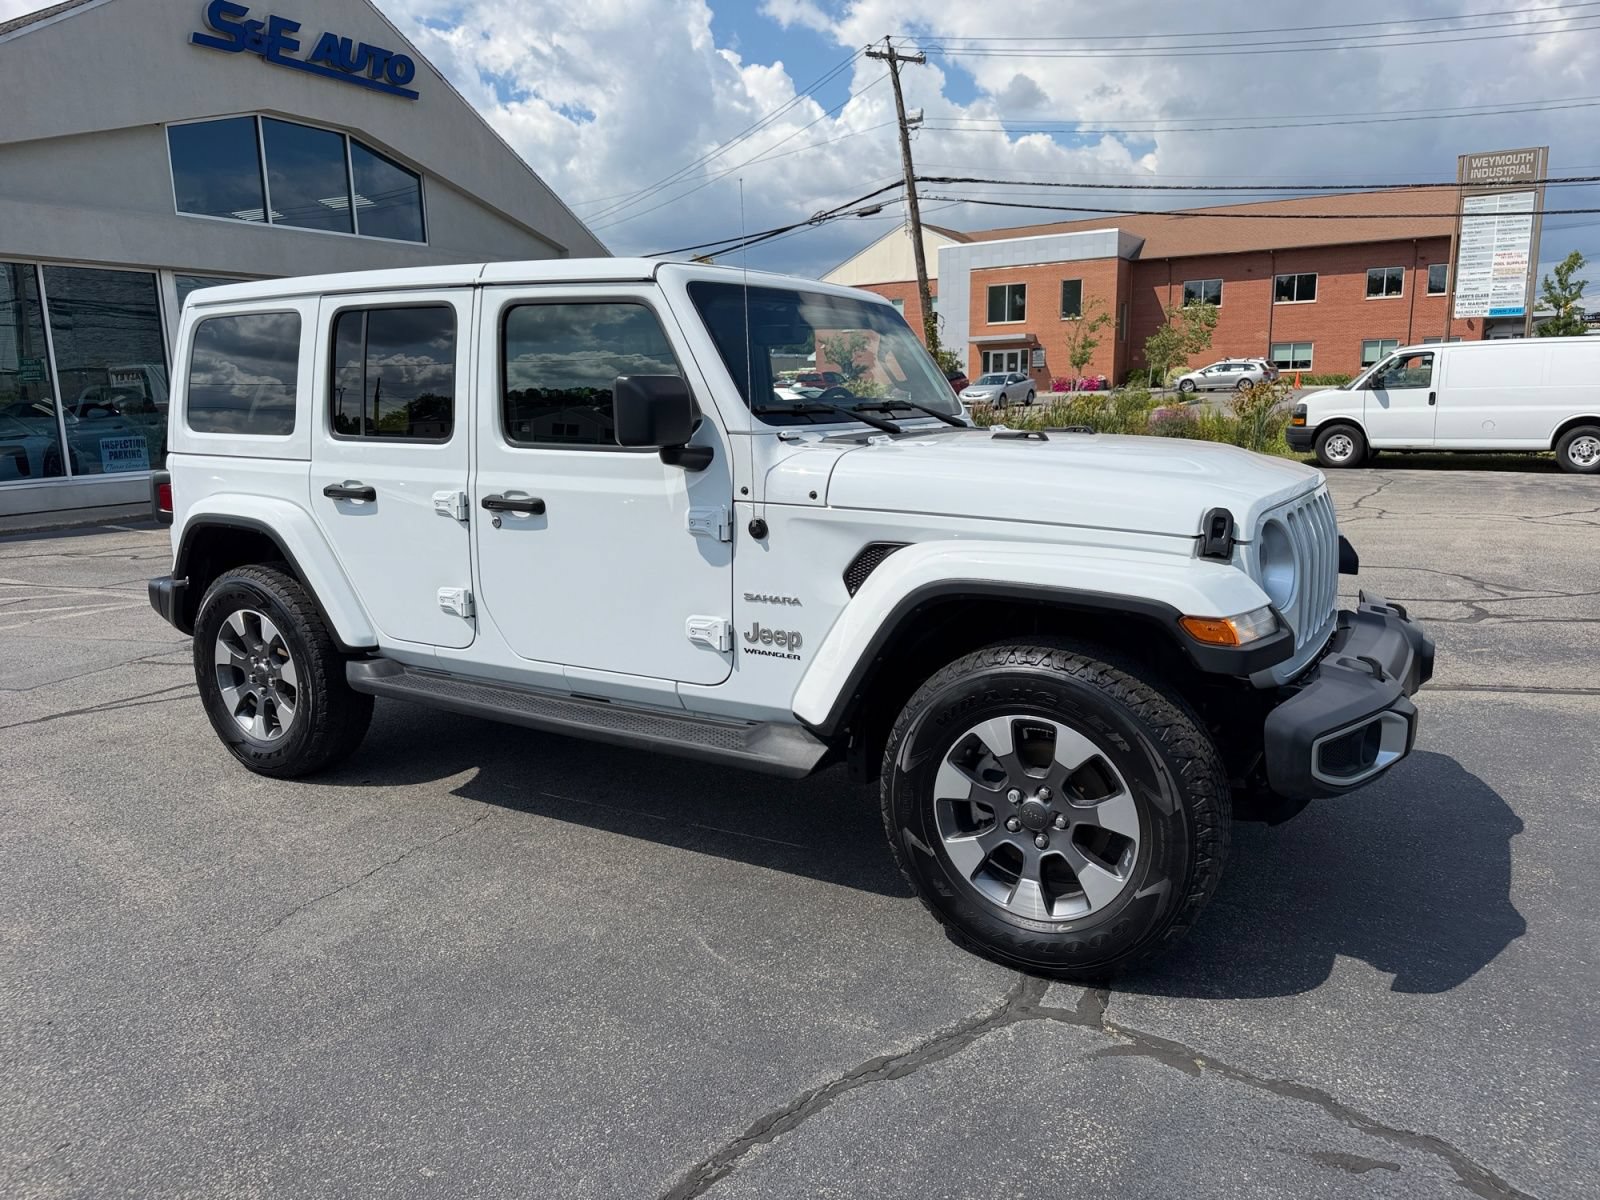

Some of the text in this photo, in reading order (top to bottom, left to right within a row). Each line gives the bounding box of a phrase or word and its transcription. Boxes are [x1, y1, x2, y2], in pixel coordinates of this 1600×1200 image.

[192, 0, 416, 86] S&E AUTO
[1471, 152, 1534, 168] WEYMOUTH
[1470, 163, 1532, 179] INDUSTRIAL
[101, 438, 146, 450] INSPECTION
[108, 449, 142, 461] PARKING
[743, 592, 803, 607] SAHARA
[743, 621, 803, 652] Jeep
[743, 647, 801, 661] WRANGLER
[935, 688, 1132, 752] WRANGLER
